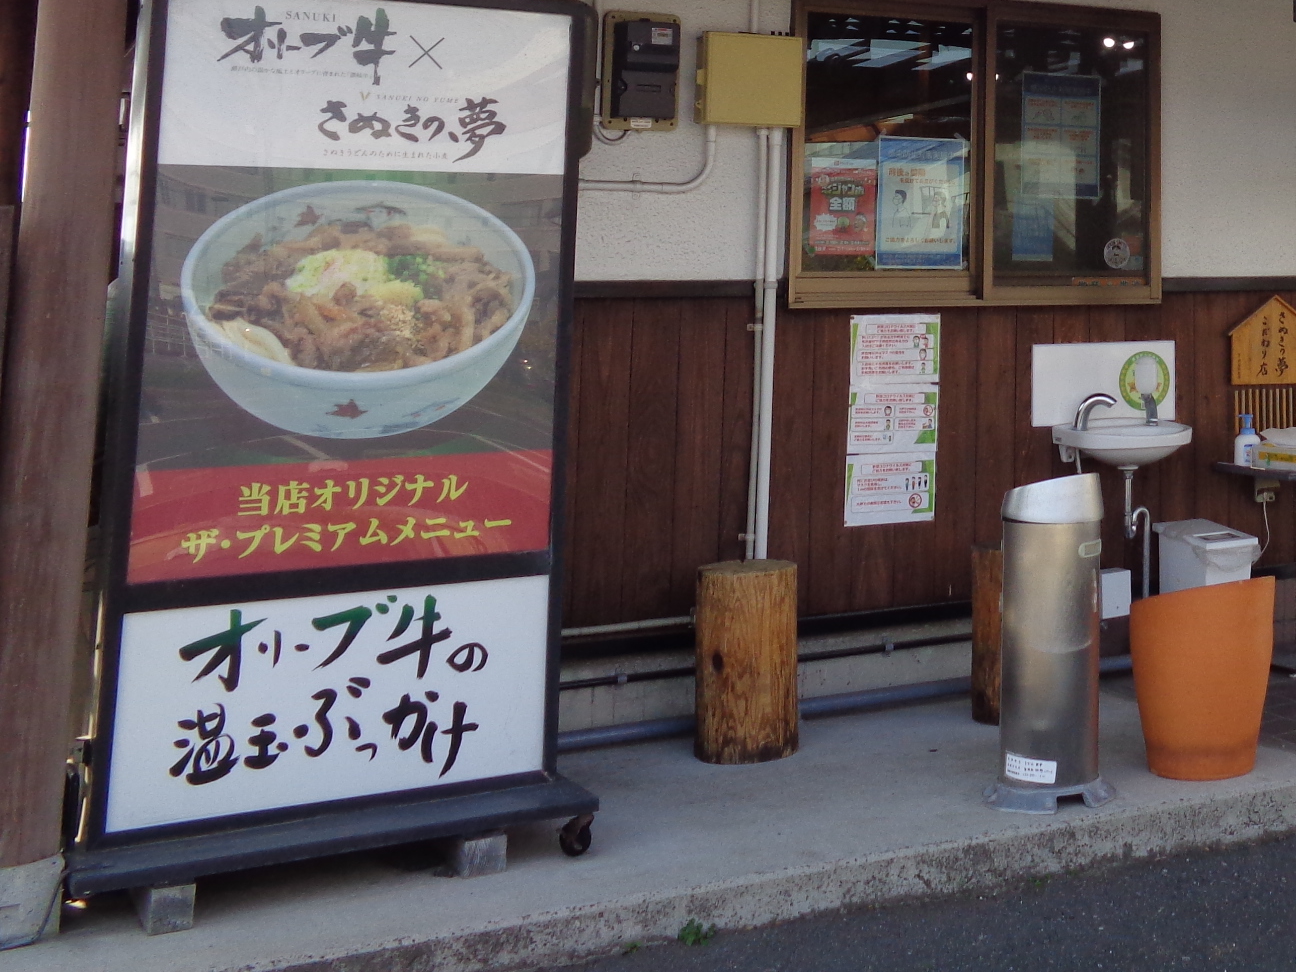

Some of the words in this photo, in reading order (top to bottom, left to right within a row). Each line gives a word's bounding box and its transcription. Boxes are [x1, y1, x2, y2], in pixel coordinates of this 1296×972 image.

[285, 9, 337, 23] SANUKI
[217, 5, 398, 86] オリーブ牛
[416, 94, 429, 103] NO
[317, 97, 507, 164] さぬきの夢
[237, 474, 469, 517] 当店オリジナル
[180, 517, 513, 564] ザ・プレミアムメニュー
[179, 594, 489, 693] オリーブ牛の
[168, 676, 480, 786] 温玉ぶっかけ
